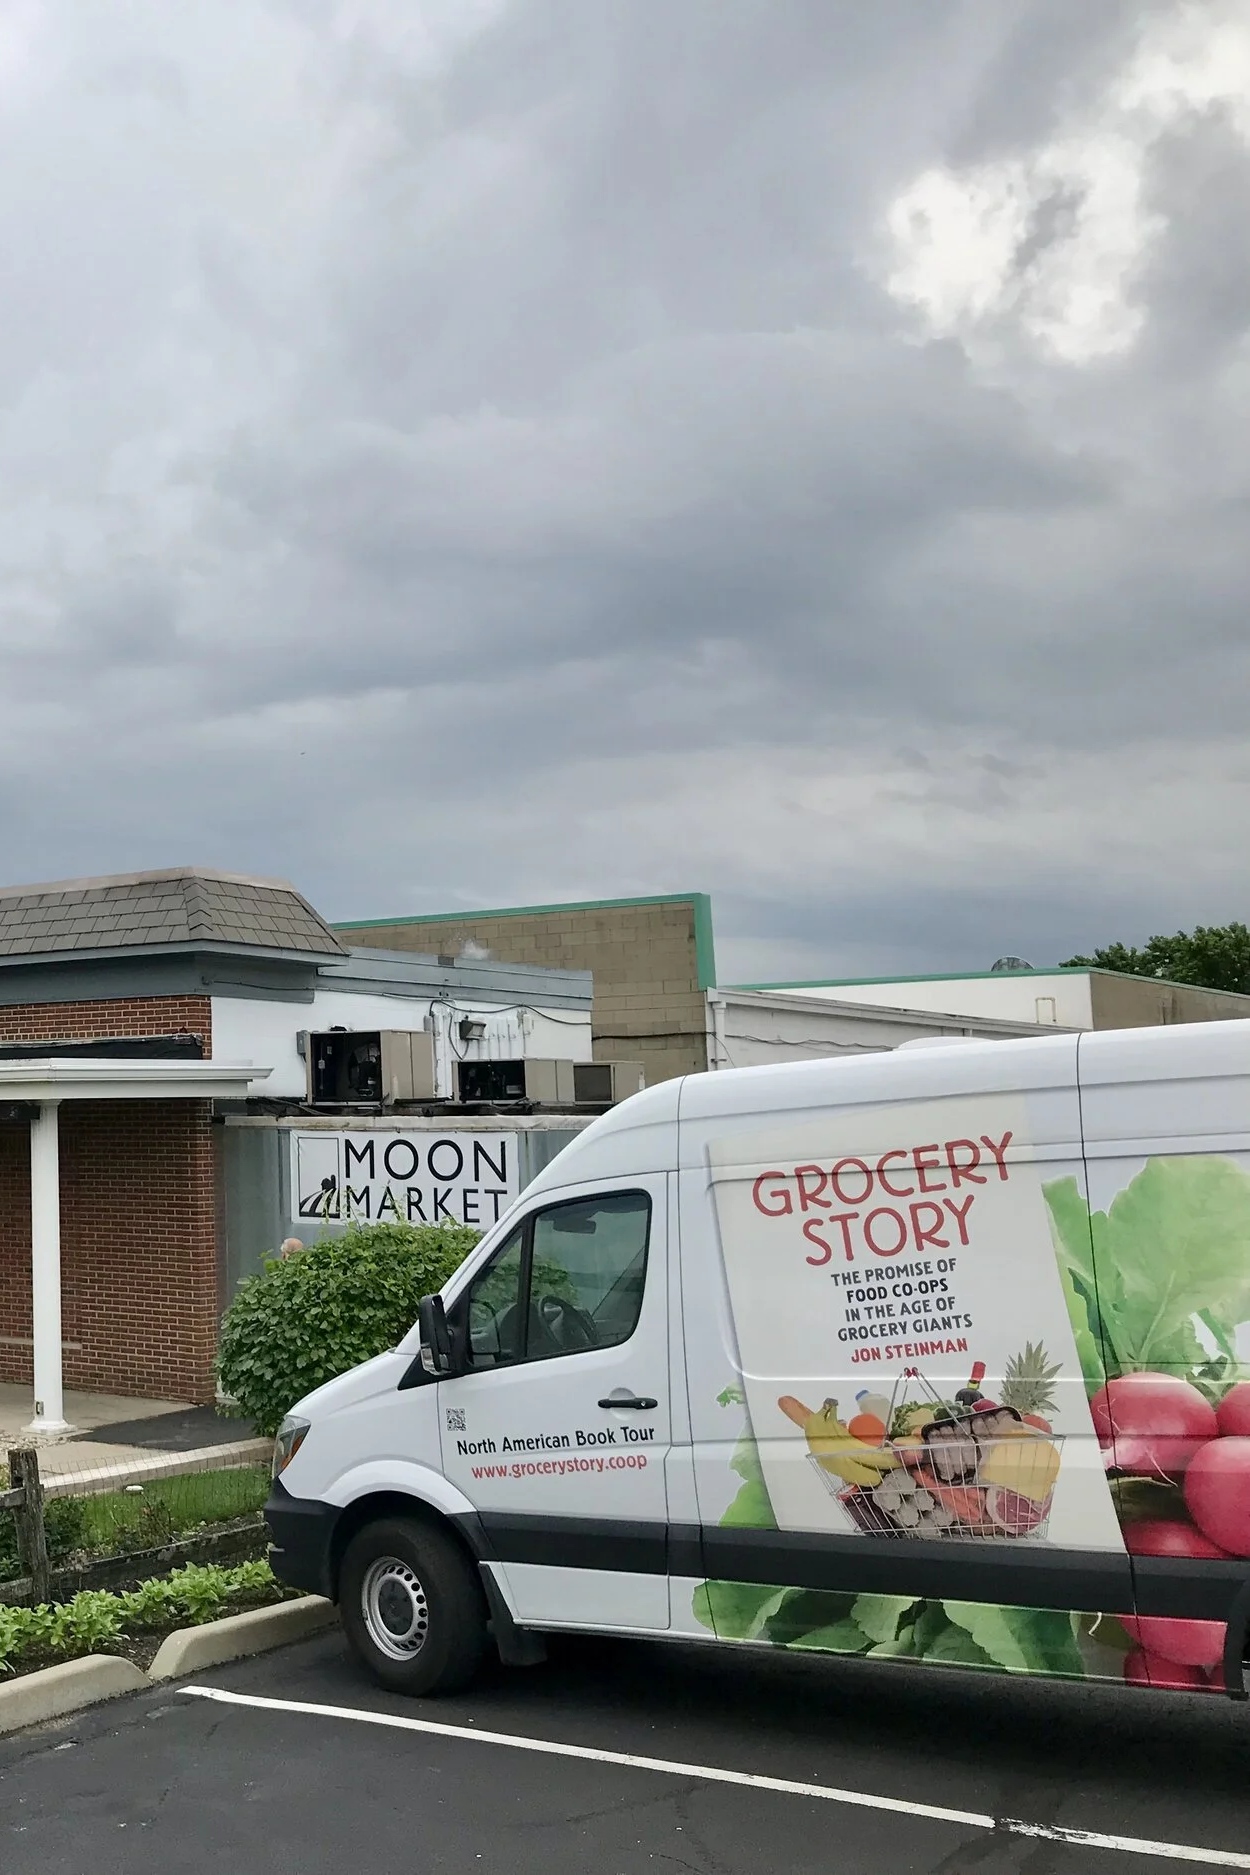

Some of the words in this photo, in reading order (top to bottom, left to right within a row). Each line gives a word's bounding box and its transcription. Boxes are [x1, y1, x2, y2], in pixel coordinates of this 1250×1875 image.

[344, 1138, 507, 1183] MOON
[752, 1131, 1013, 1217] GROCERY
[345, 1185, 508, 1224] MARKET
[802, 1194, 975, 1266] STORY
[830, 1271, 861, 1286] THE
[865, 1261, 933, 1282] PROMISE
[937, 1258, 957, 1273] OF
[847, 1286, 888, 1303] FOOD
[892, 1278, 949, 1298] CO-OPS
[845, 1308, 861, 1322] IN
[864, 1304, 895, 1320] THE
[900, 1299, 932, 1315] AGE
[936, 1296, 956, 1311] OF
[837, 1321, 907, 1342] GROCERY
[912, 1313, 973, 1333] GIANTS
[851, 1347, 881, 1363] JON
[885, 1338, 968, 1360] STEINMAN
[456, 1438, 496, 1456] North
[502, 1433, 570, 1452] American
[575, 1428, 616, 1446] Book
[620, 1426, 655, 1441] Tour
[471, 1454, 648, 1479] www.grocerystory.coop
